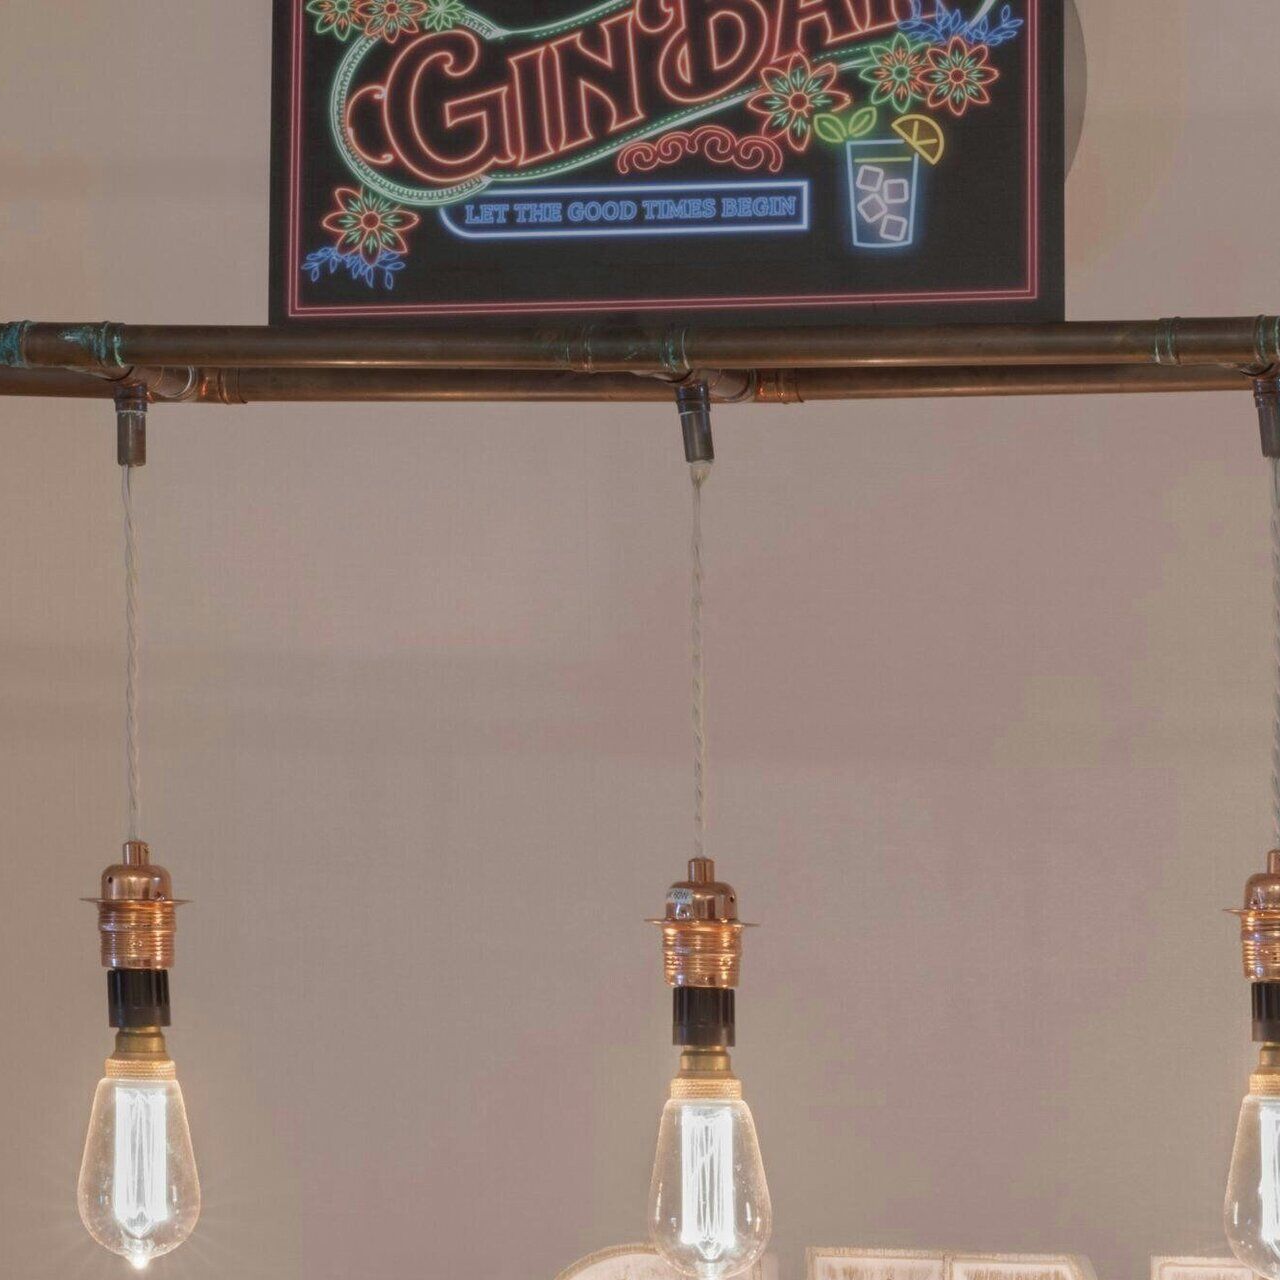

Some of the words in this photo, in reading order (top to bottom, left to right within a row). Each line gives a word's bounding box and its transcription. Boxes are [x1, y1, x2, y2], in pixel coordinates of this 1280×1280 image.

[347, 8, 645, 182] GIN
[658, 0, 938, 103] BA
[465, 204, 510, 224] LET
[513, 202, 563, 223] THE
[567, 199, 638, 222] GOOD
[642, 197, 717, 220] TIMES
[720, 195, 797, 218] BEGIN
